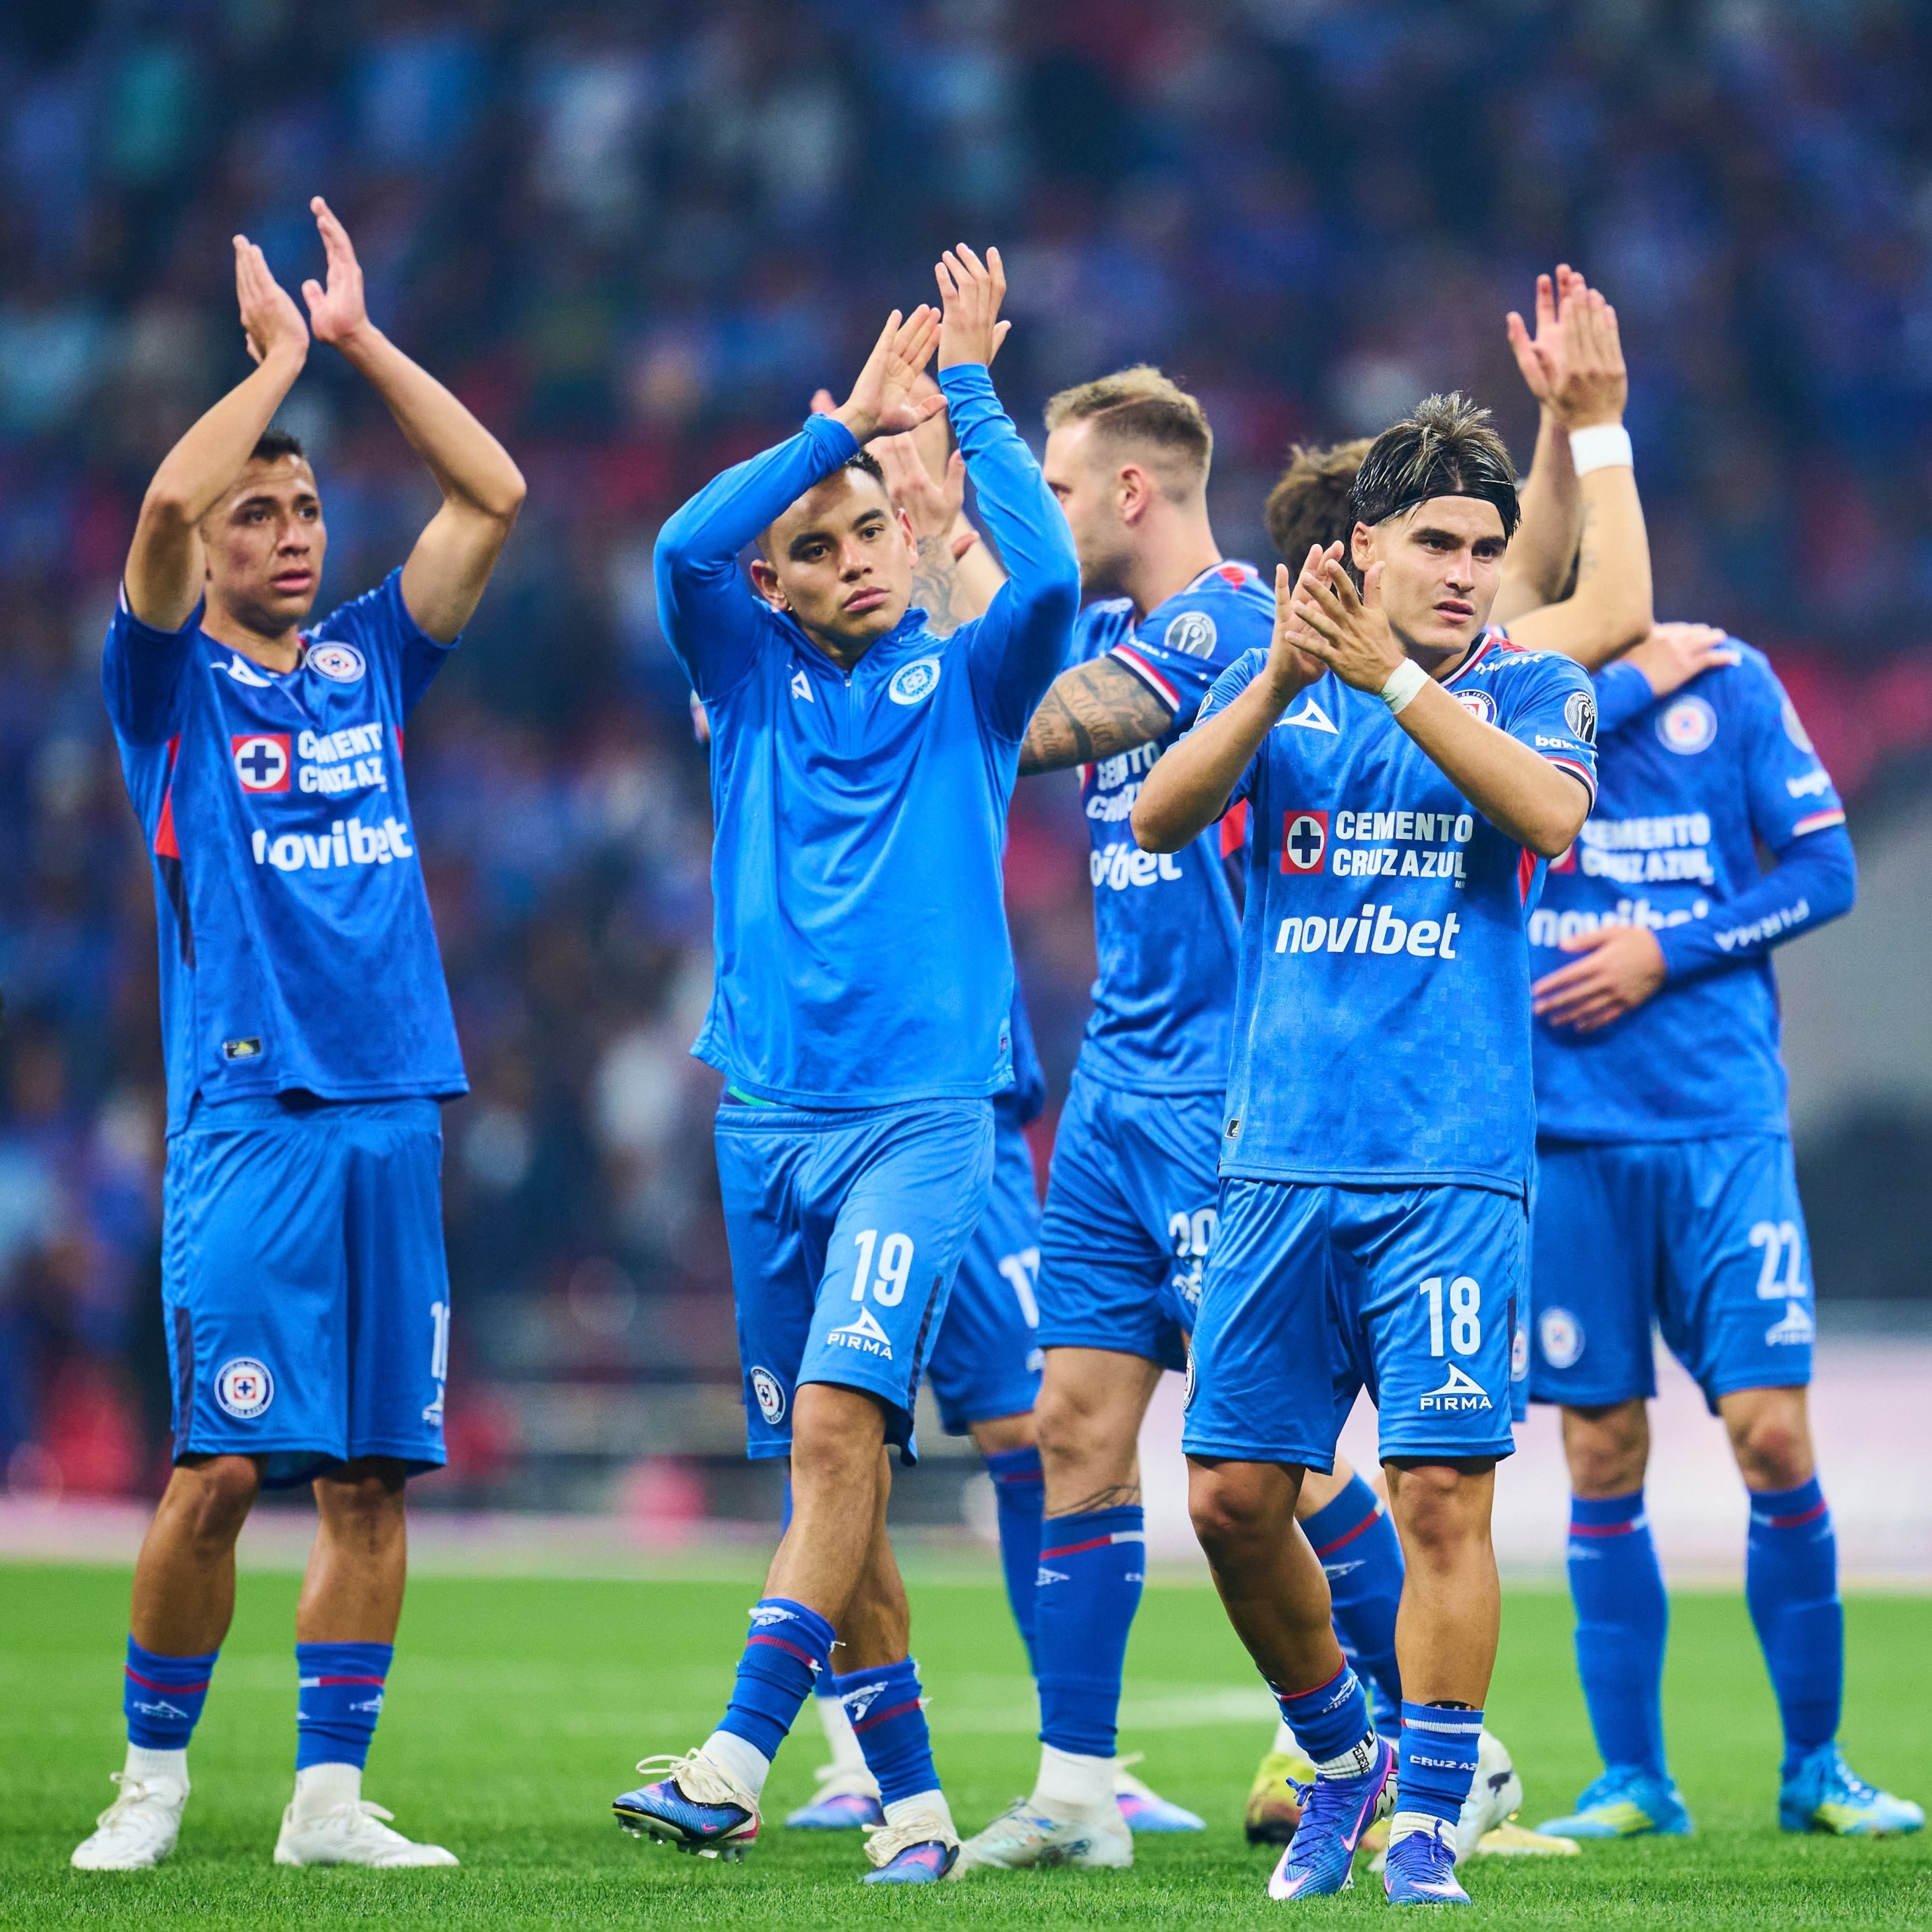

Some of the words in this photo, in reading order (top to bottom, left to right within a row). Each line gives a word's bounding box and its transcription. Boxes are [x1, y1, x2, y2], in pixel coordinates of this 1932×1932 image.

[1335, 810, 1474, 842] CEMENTO
[1332, 848, 1398, 877] CRUZ
[1399, 849, 1467, 879] AZUL
[1455, 880, 1465, 889] MR
[1275, 903, 1461, 959] novibet
[850, 1229, 914, 1307] 19
[1748, 1220, 1808, 1300] 22
[1419, 1276, 1481, 1357] 18
[826, 1333, 893, 1361] PIRMA
[1419, 1395, 1493, 1411] PIRMA
[1409, 1755, 1457, 1769] CRUZ
[1458, 1762, 1478, 1771] AZ
